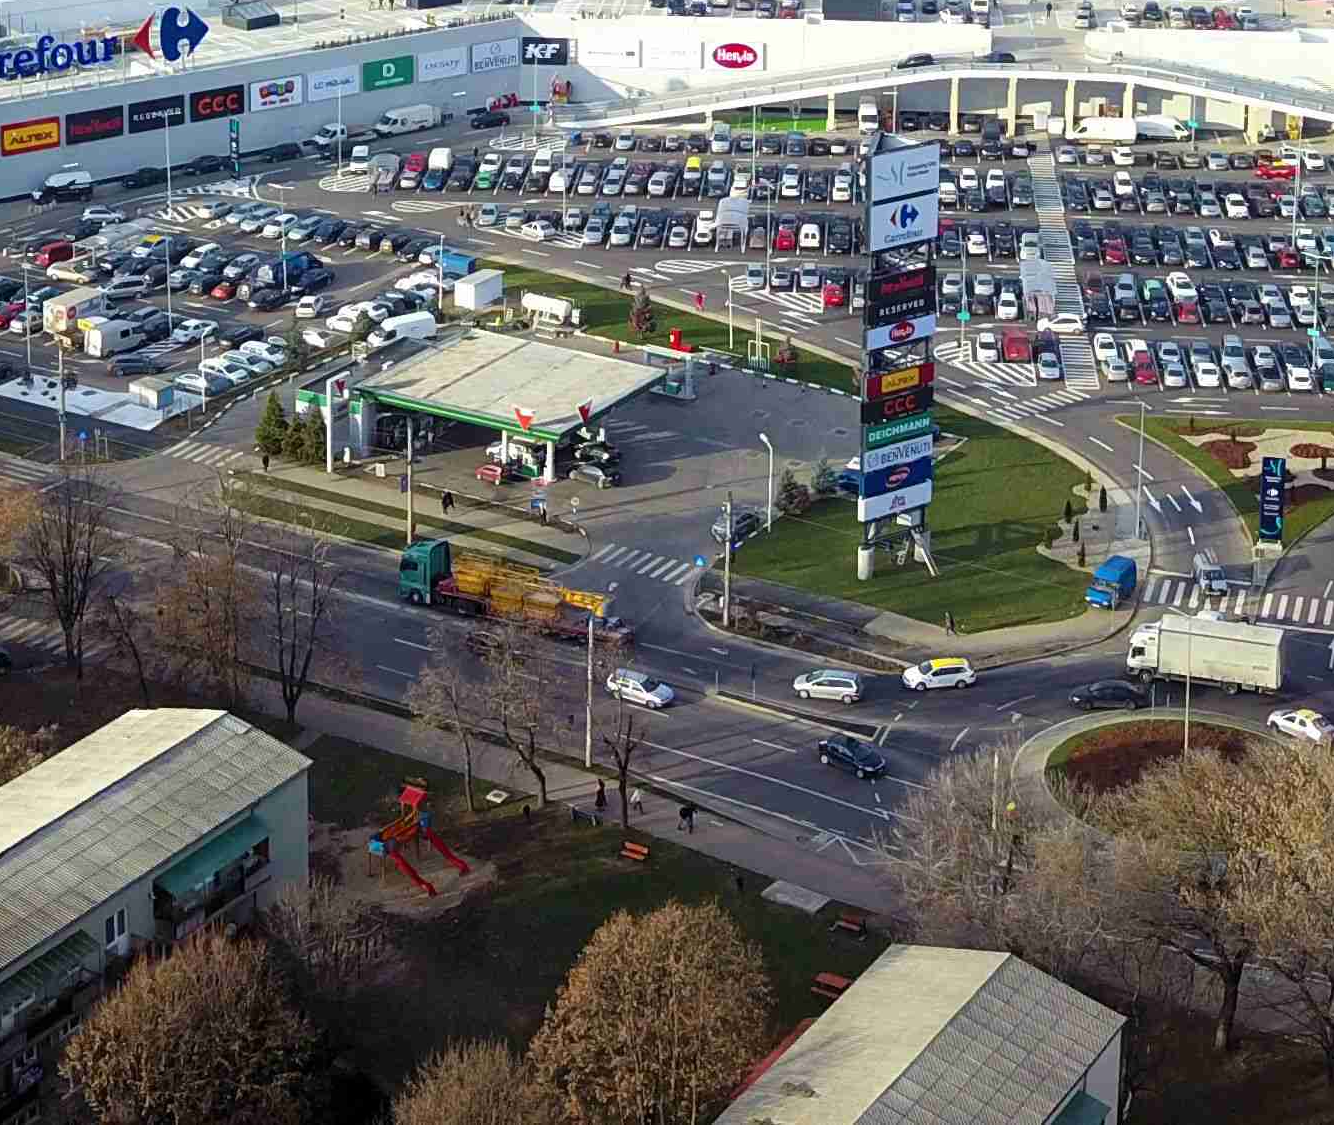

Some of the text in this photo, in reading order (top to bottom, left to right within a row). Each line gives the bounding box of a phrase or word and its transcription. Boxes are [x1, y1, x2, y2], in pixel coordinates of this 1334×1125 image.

[198, 93, 240, 115] CCC
[10, 130, 54, 146] ALTEX
[878, 298, 926, 317] RESERVED
[883, 394, 916, 415] CCC
[868, 416, 931, 443] DEICHMANN
[880, 441, 931, 465] BENVENUTI
